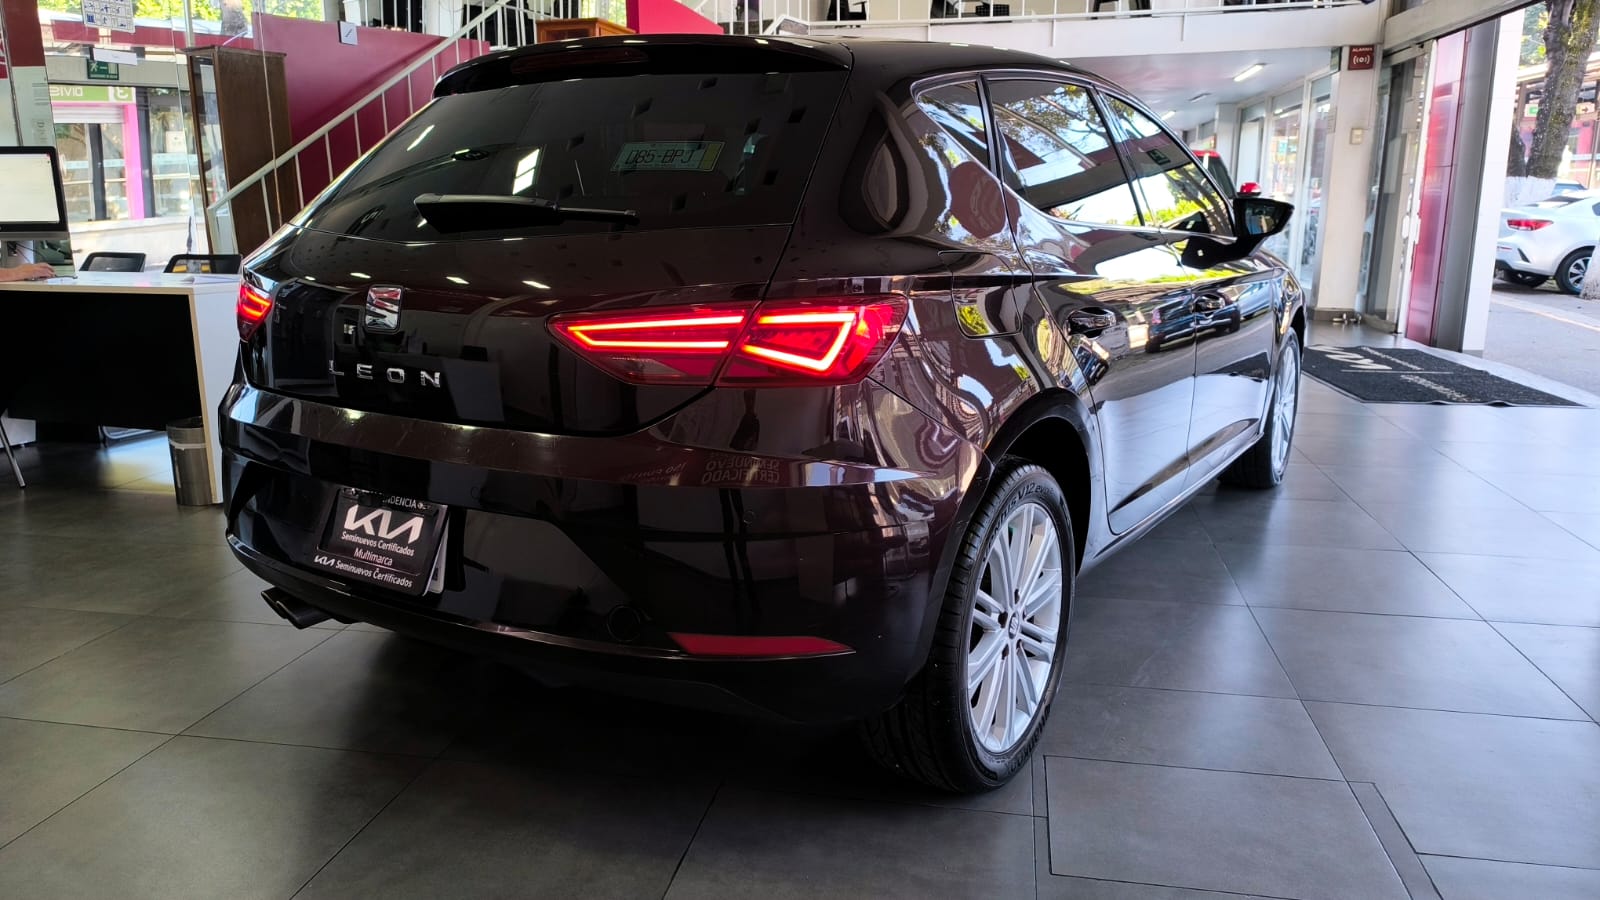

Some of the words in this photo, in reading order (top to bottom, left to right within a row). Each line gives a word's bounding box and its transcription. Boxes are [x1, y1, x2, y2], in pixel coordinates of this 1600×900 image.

[329, 360, 441, 388] LEON
[344, 504, 424, 544] KIA
[341, 531, 377, 547] Seminuevos
[378, 540, 415, 557] Certificados
[354, 548, 393, 566] Multimarca
[314, 555, 335, 566] KIA
[336, 560, 372, 578] Seminuevos
[373, 570, 412, 587] Certificados
